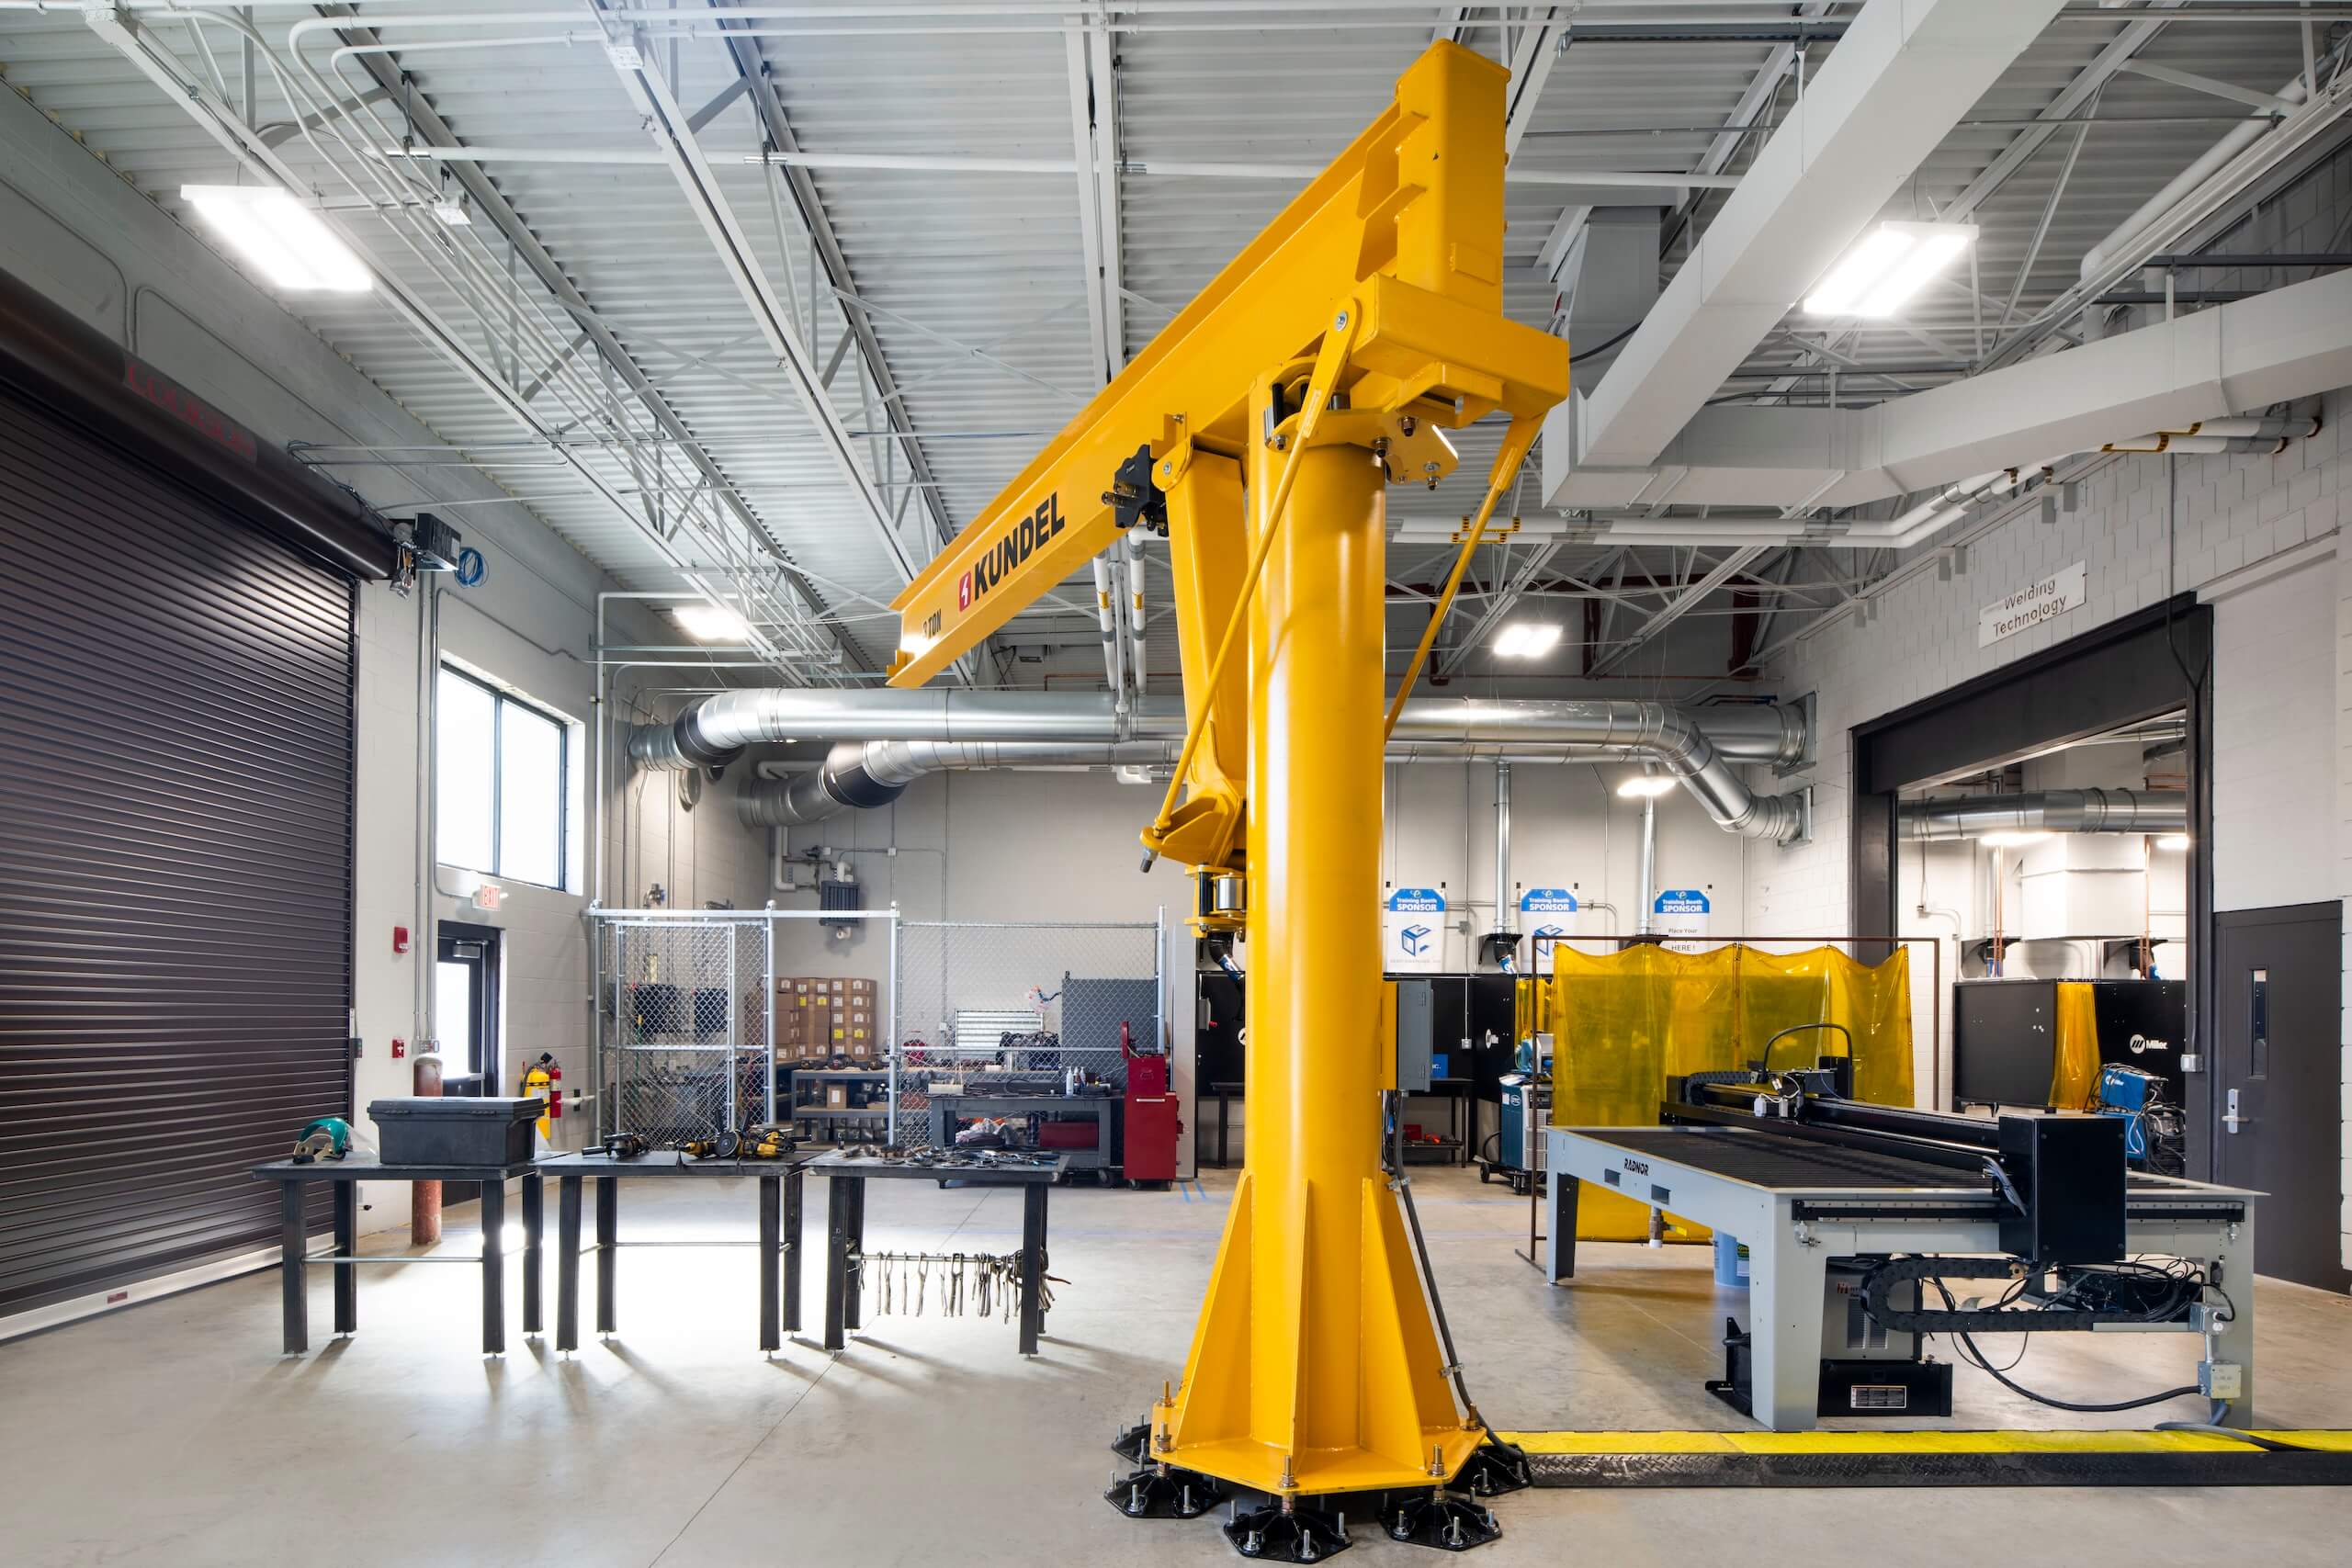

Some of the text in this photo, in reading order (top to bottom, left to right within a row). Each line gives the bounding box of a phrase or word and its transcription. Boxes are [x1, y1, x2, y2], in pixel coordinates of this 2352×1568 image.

[974, 491, 1065, 601] KUNDEL
[2004, 579, 2056, 611] Welding
[928, 608, 942, 639] TON
[1993, 594, 2067, 637] Technology
[484, 886, 500, 907] EXIT
[1623, 1157, 1649, 1176] RADNOR
